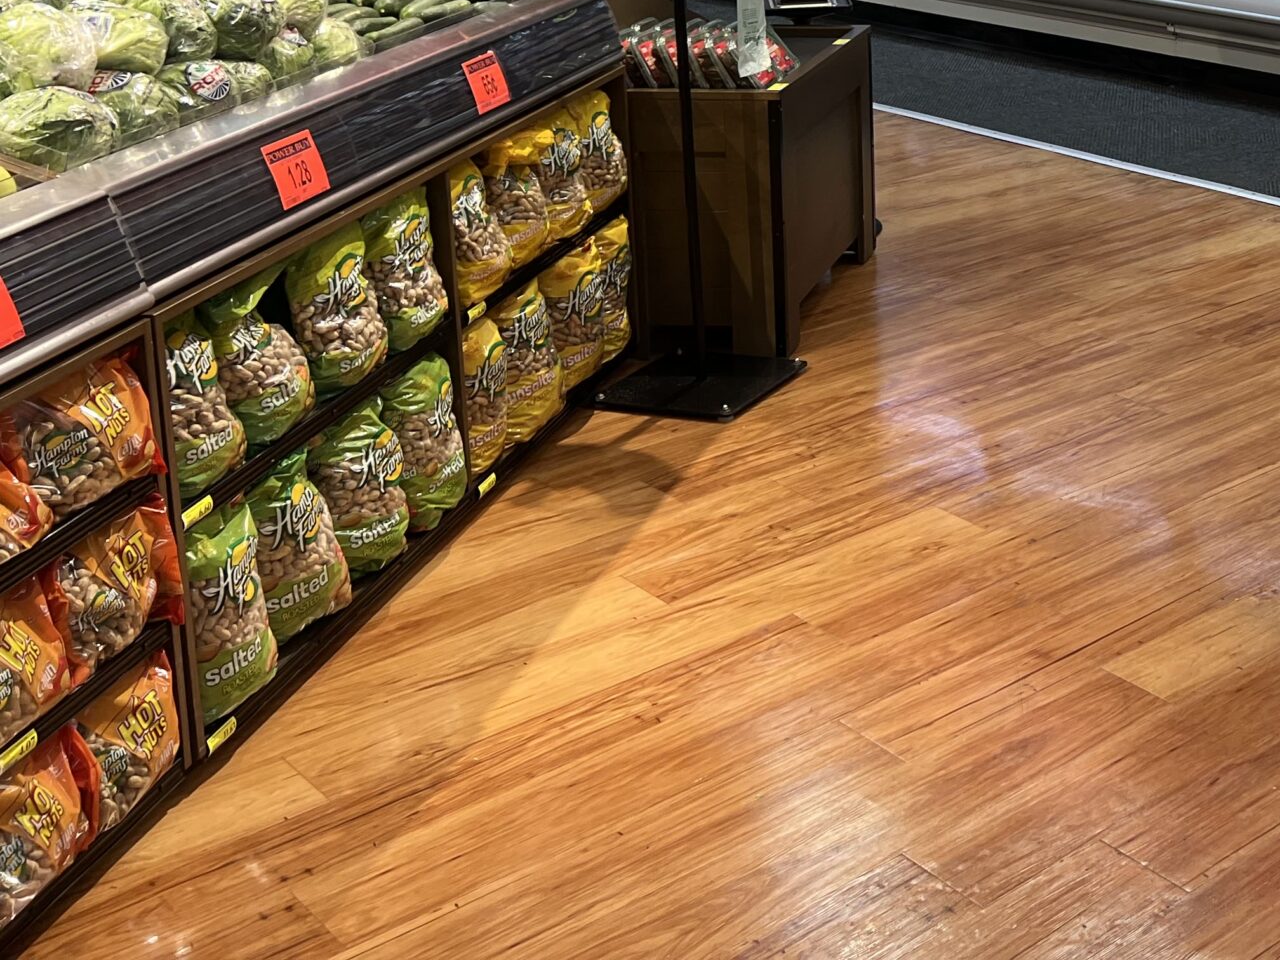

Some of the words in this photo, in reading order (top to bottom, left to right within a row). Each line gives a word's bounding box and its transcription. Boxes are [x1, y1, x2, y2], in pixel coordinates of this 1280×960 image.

[265, 145, 296, 162] POWER
[294, 139, 311, 152] BUY
[287, 159, 312, 189] 1.28
[104, 406, 131, 447] NUTS
[186, 420, 233, 464] salted
[34, 427, 89, 477] Hampton
[47, 440, 88, 478] Farms
[265, 564, 329, 614] salted
[204, 631, 263, 687] salted
[117, 689, 163, 751] HOT
[140, 715, 168, 761] NUTS
